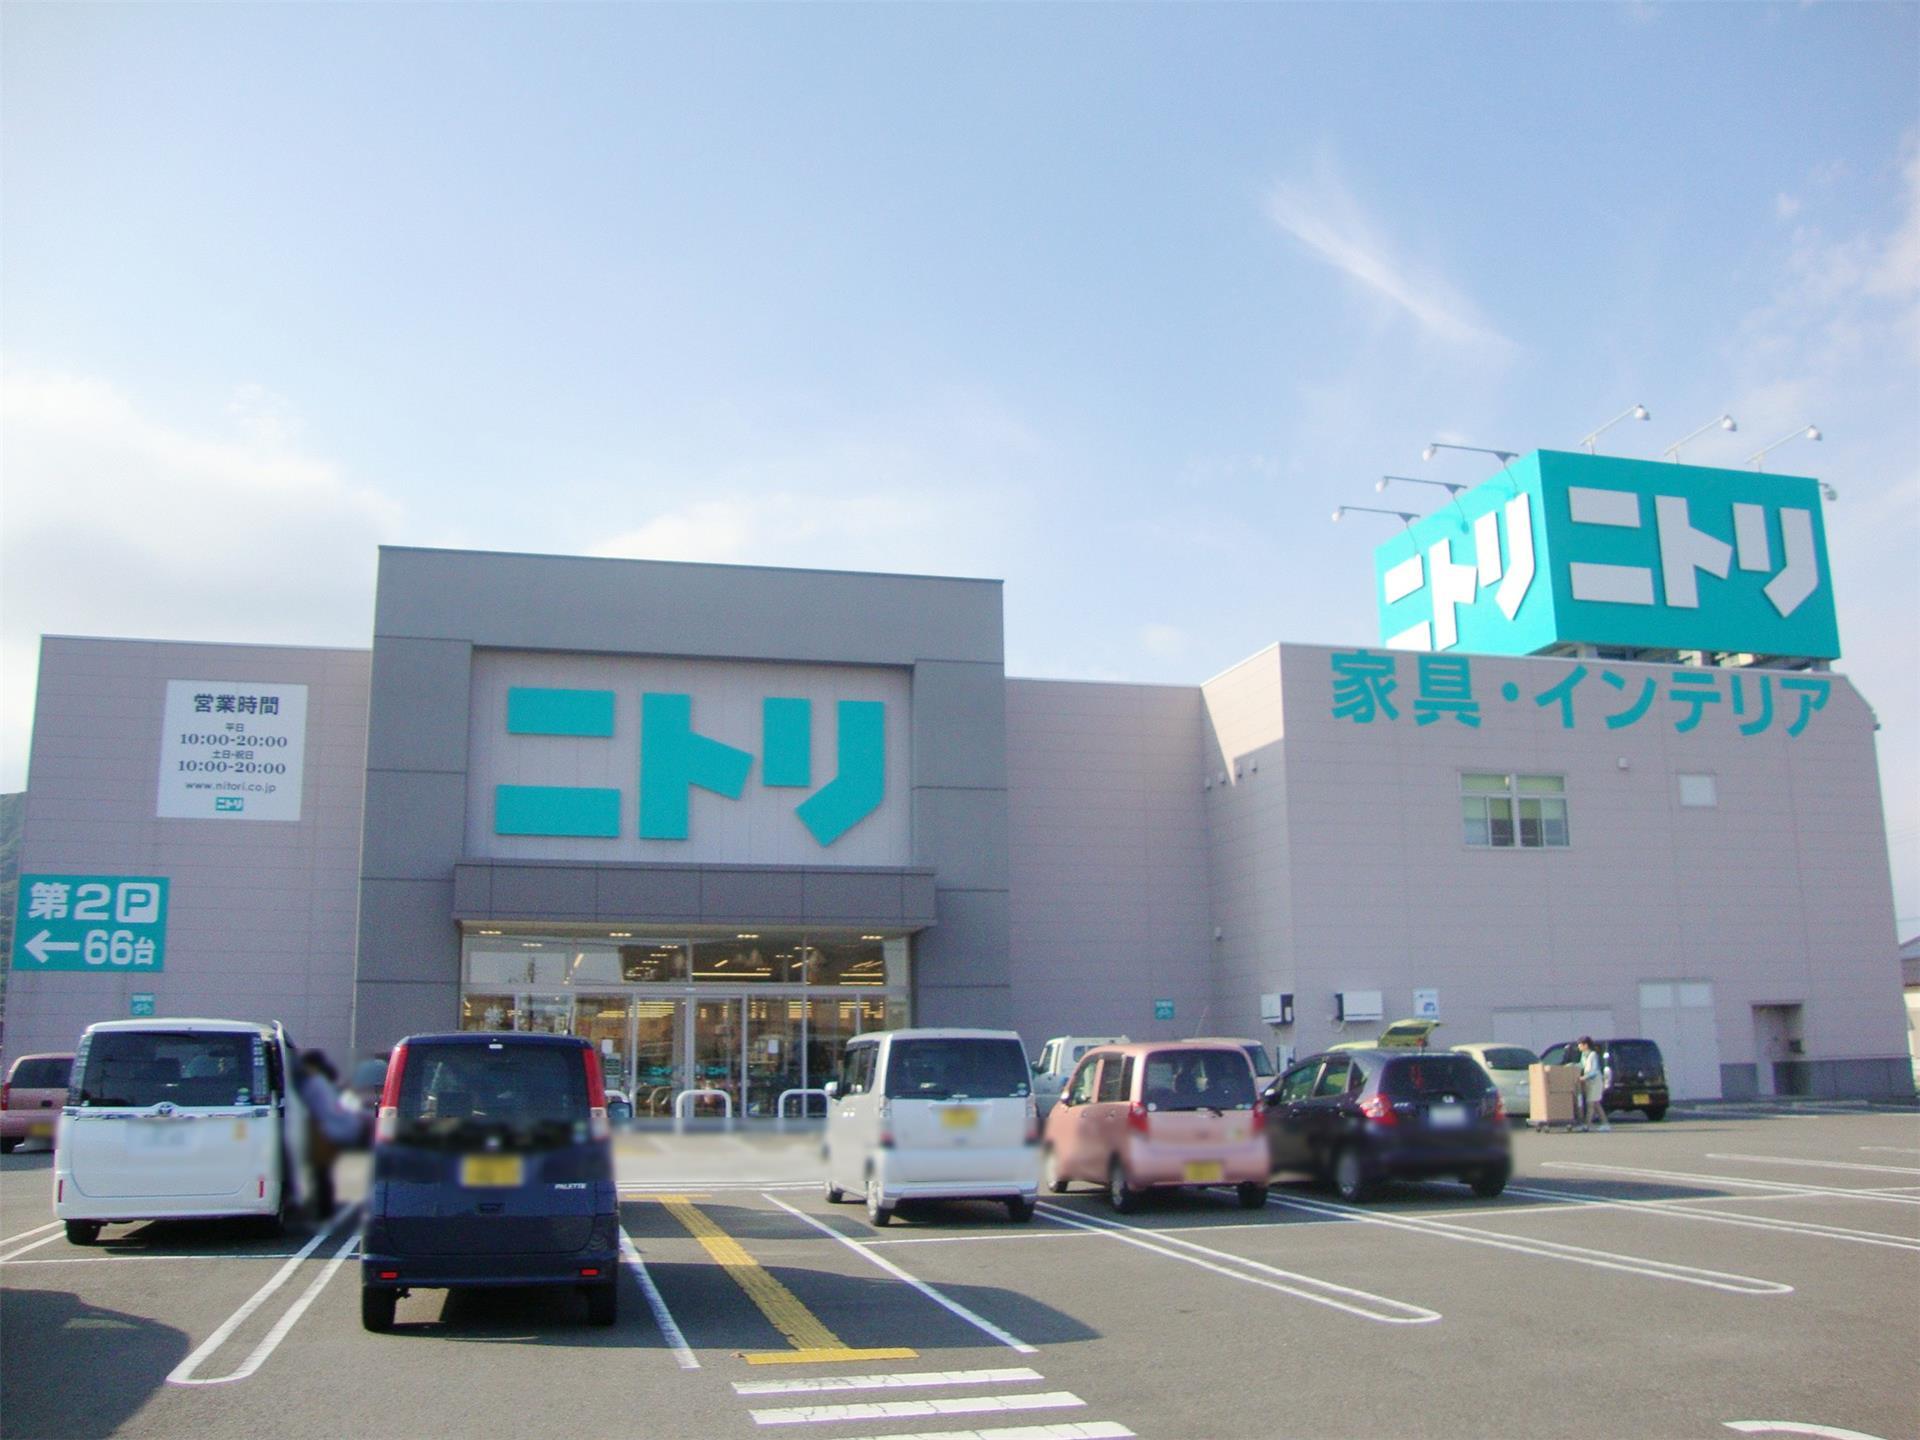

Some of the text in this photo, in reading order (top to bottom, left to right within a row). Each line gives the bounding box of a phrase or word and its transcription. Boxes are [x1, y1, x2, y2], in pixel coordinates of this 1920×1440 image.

[1568, 485, 1819, 618] ニトリ
[1384, 492, 1535, 651] ニトリ
[194, 693, 280, 715] 営業時間
[1330, 649, 1831, 738] 家具・インテリア
[180, 733, 288, 748] 10:00-20:00
[225, 722, 245, 733] 平日
[177, 759, 287, 775] 10:00-20:00
[495, 687, 885, 848] ニトリ
[185, 780, 277, 794] www.nitori.co.jp
[84, 928, 156, 966] 66台
